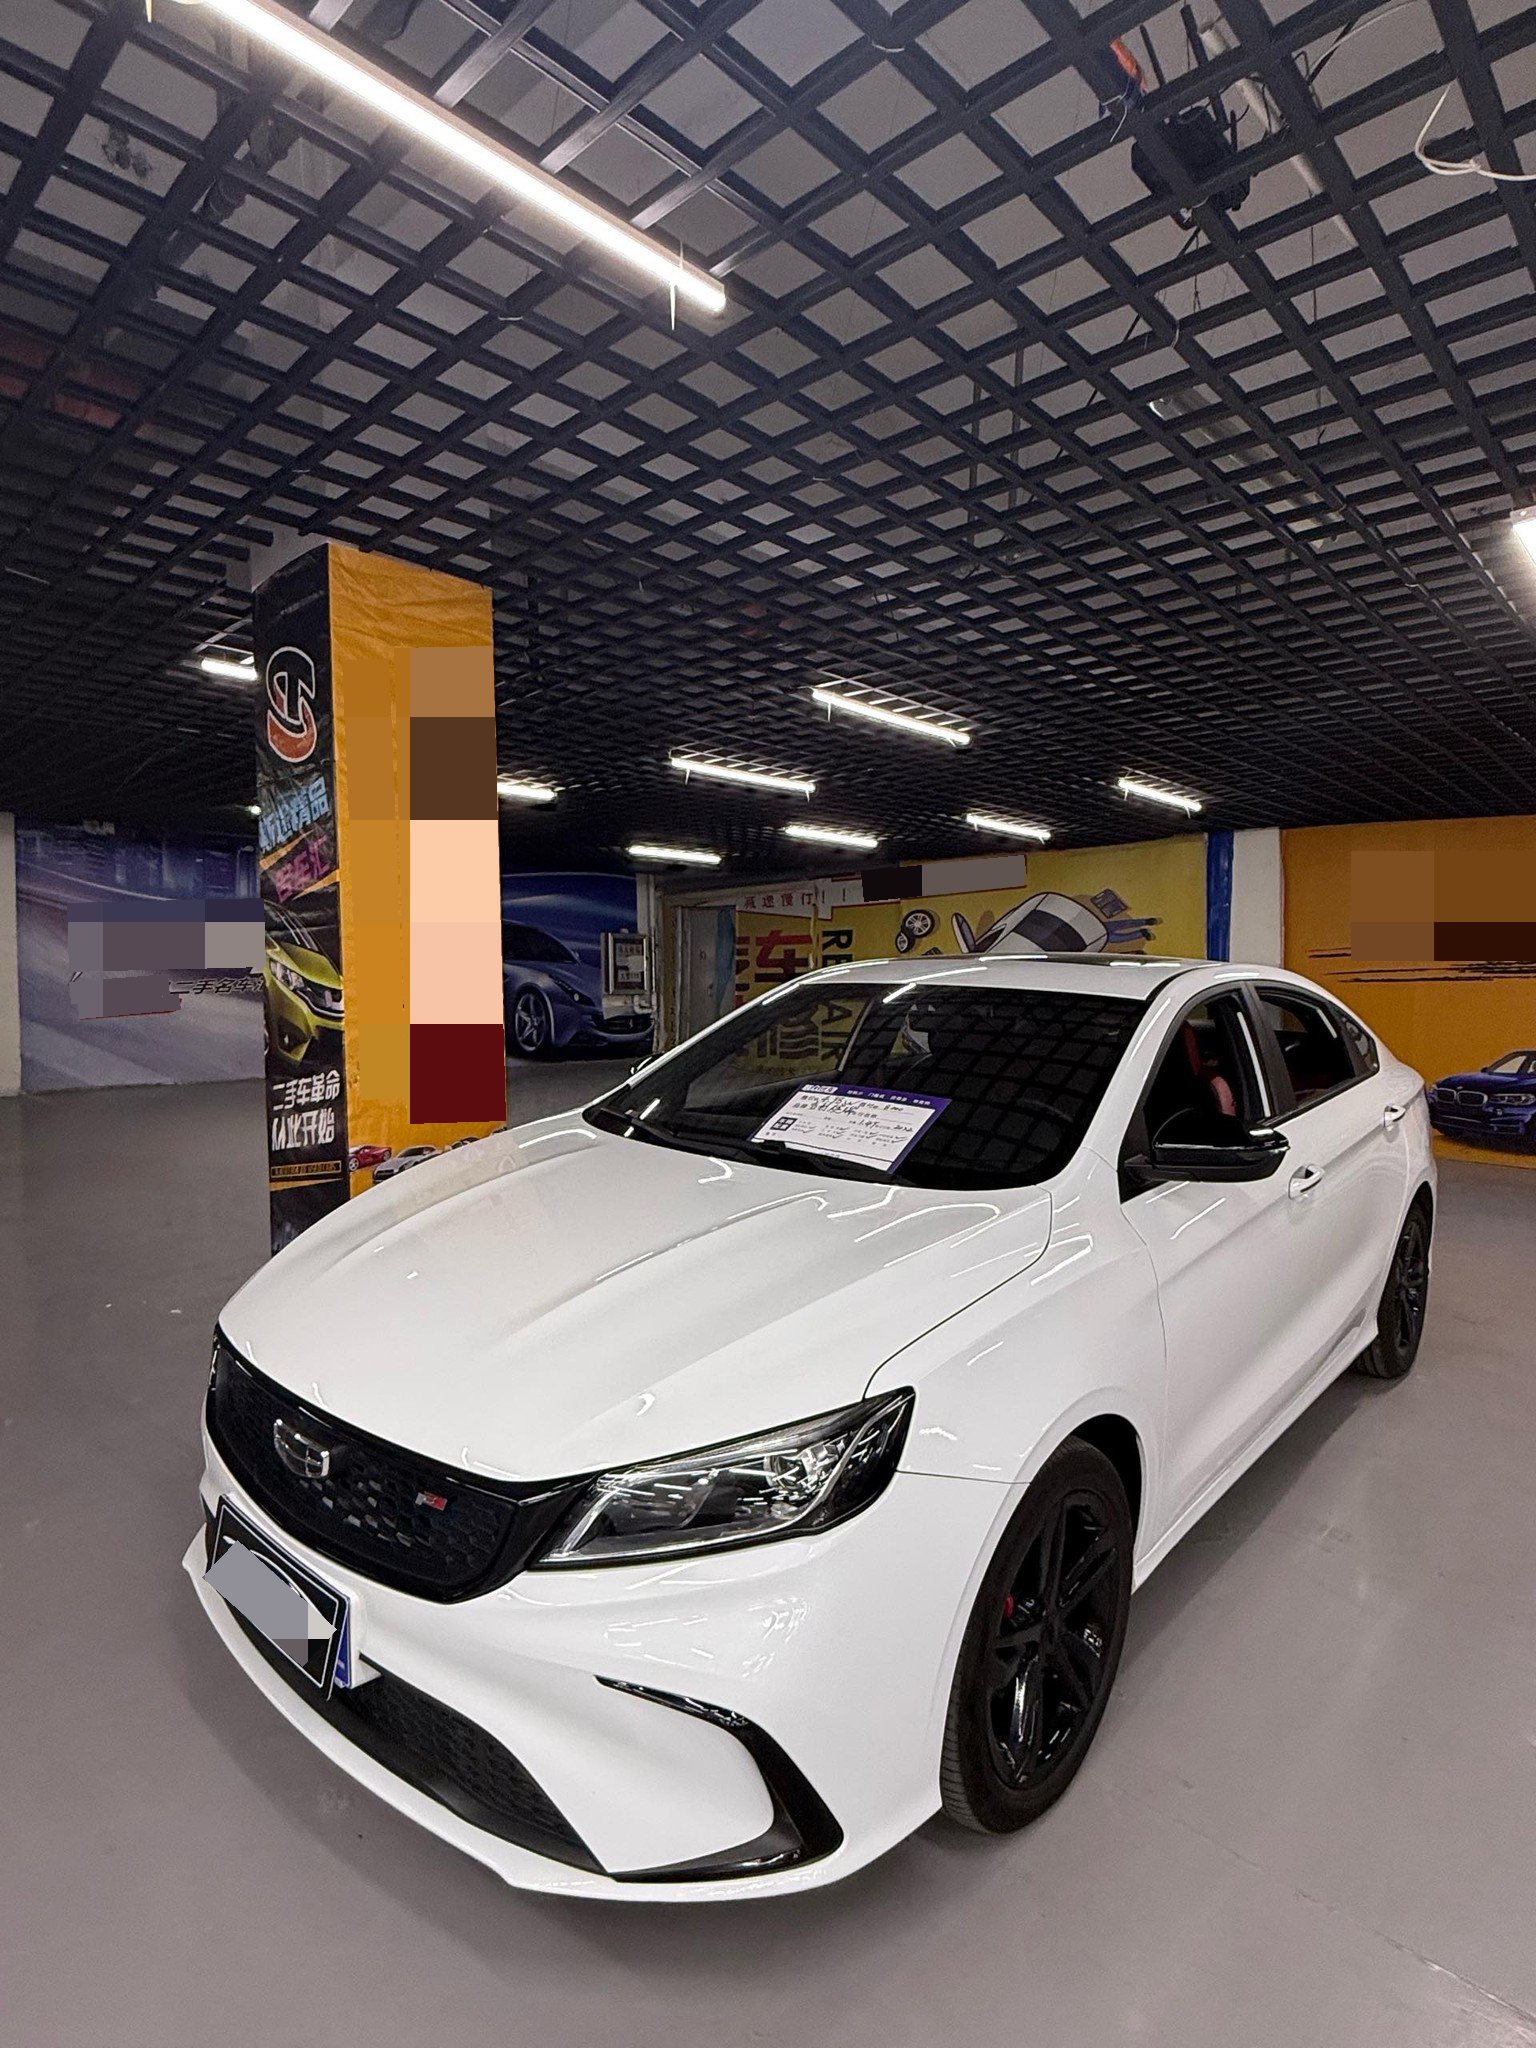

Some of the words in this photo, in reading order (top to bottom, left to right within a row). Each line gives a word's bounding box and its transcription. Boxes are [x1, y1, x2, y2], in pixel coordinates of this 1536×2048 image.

[272, 1069, 341, 1111] 二手车革命
[271, 1106, 335, 1151] 从此开始
